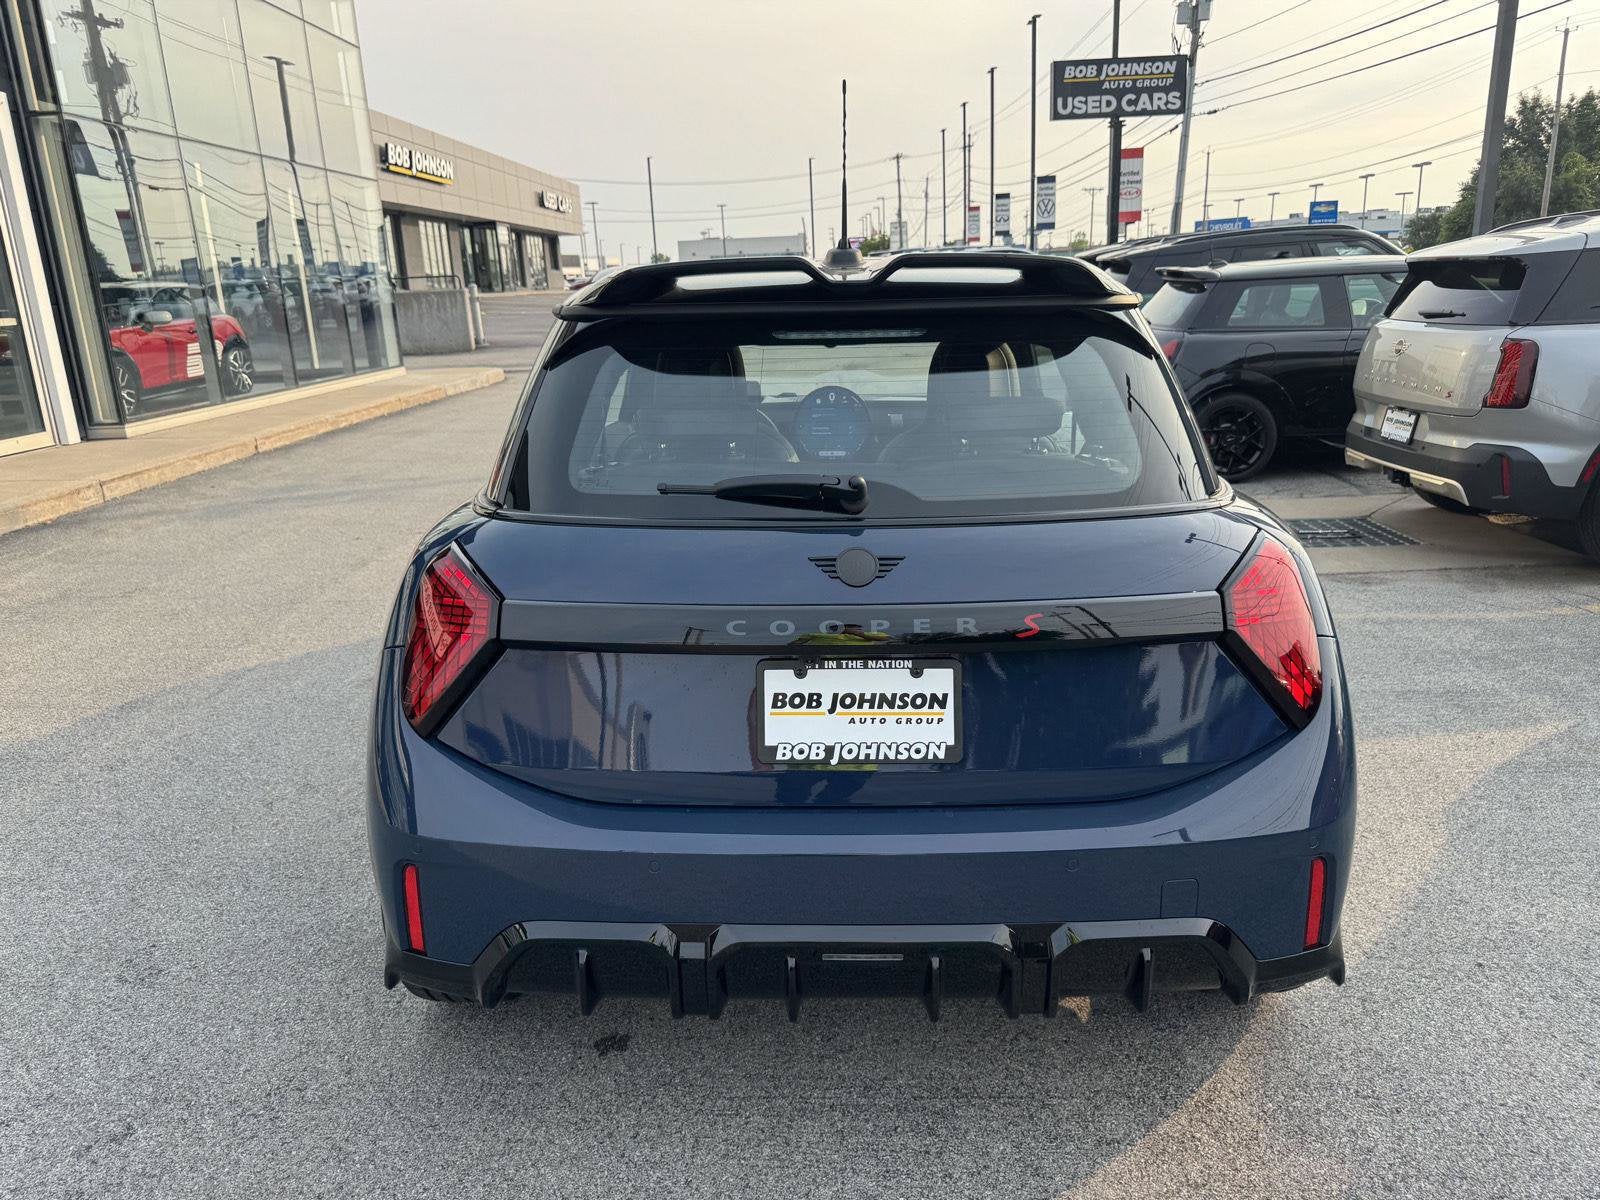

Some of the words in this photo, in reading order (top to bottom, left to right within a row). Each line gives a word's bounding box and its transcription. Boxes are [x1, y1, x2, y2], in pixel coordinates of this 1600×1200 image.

[1064, 64, 1098, 79] BOB
[1099, 61, 1177, 80] JOHNSON
[1102, 81, 1132, 89] AUTO
[1136, 78, 1174, 87] GROUP
[1057, 95, 1117, 115] USED
[1121, 91, 1181, 112] CARS
[387, 143, 410, 168] BOB
[411, 150, 453, 179] JOHNSON
[725, 618, 979, 636] COOPER
[1015, 613, 1044, 639] S
[824, 660, 837, 669] IN
[840, 660, 864, 669] THE
[867, 660, 912, 669] NATION
[771, 693, 822, 710] BOB
[828, 692, 948, 714] JOHNSON
[848, 717, 887, 725] AUTO
[896, 717, 944, 725] GROUP
[776, 742, 826, 761] BOB
[830, 742, 946, 766] JOHNSON
